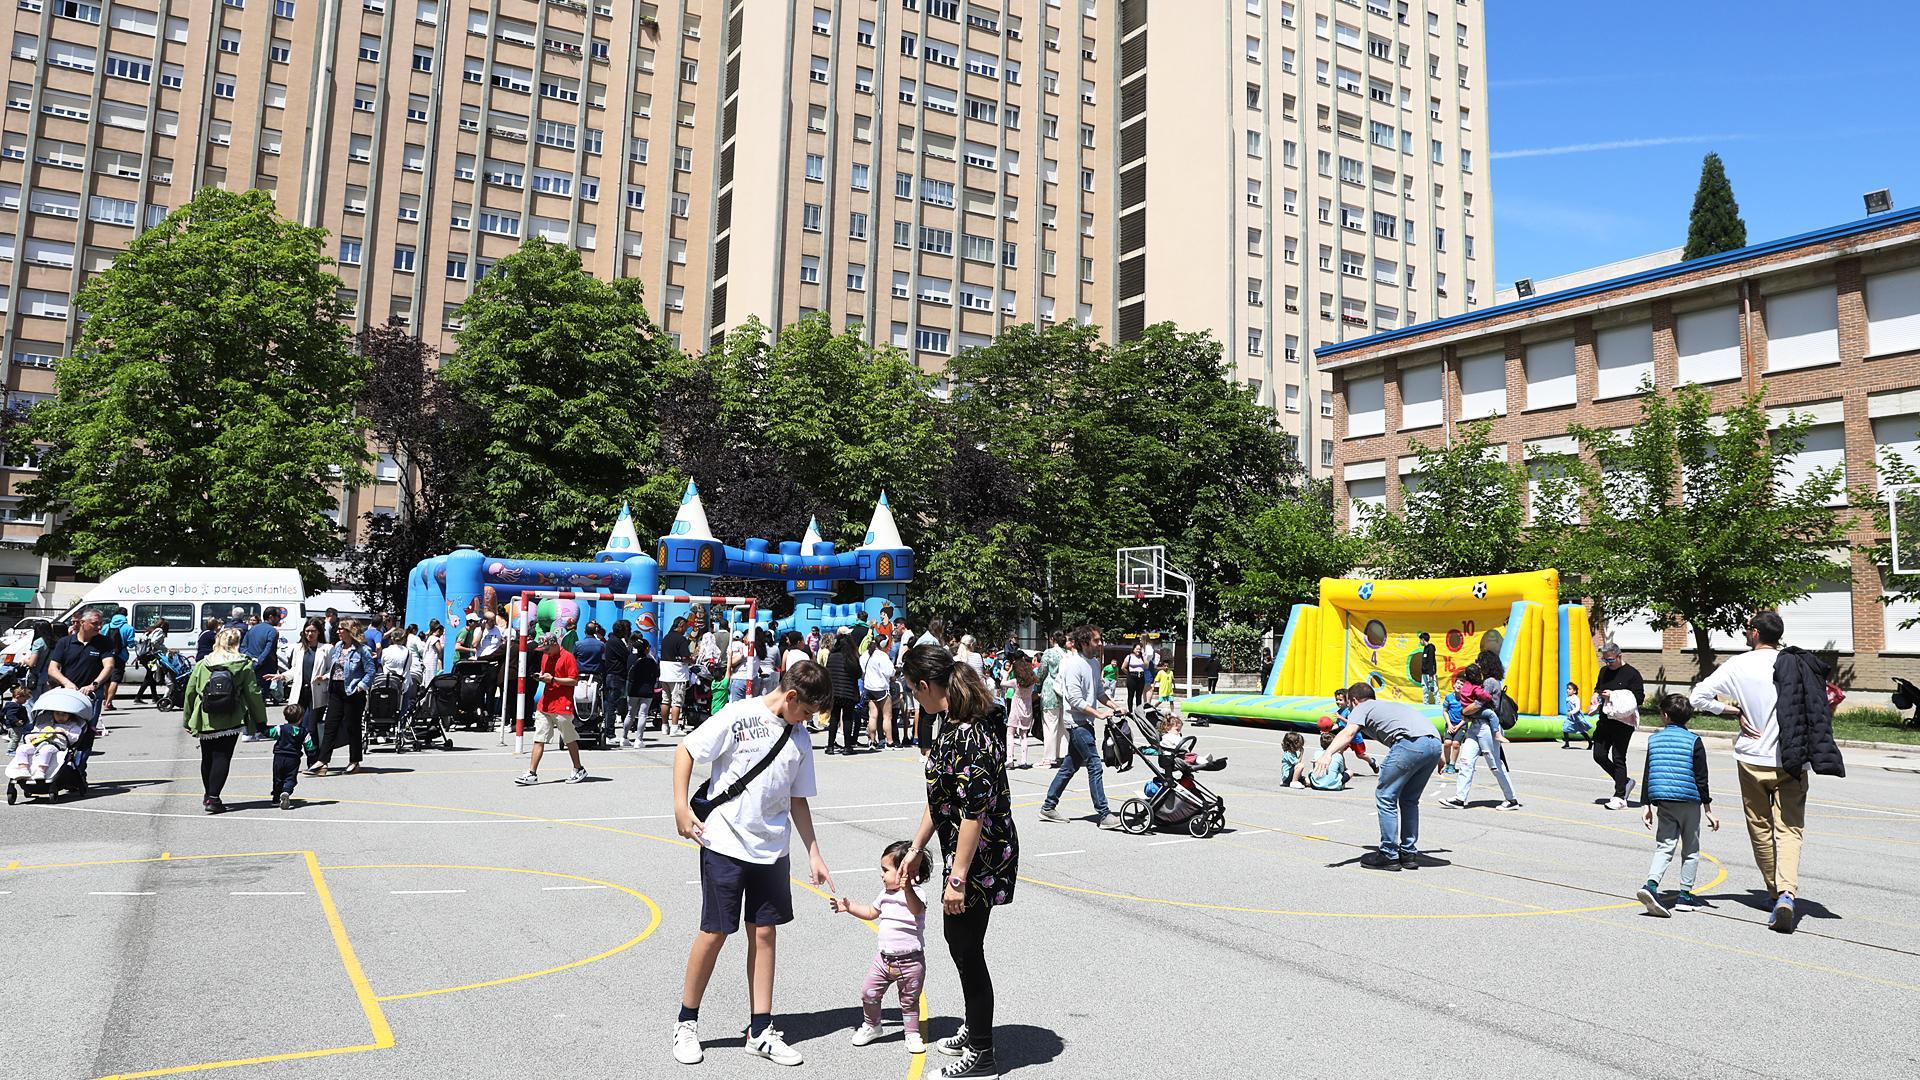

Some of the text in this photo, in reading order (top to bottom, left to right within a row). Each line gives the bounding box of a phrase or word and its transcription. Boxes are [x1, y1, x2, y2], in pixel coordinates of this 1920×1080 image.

[118, 584, 297, 596] vuelos en globo parques infantiles
[1461, 620, 1475, 636] 10
[1371, 651, 1378, 665] 4
[732, 716, 764, 733] QUIK
[734, 727, 770, 743] SILVER
